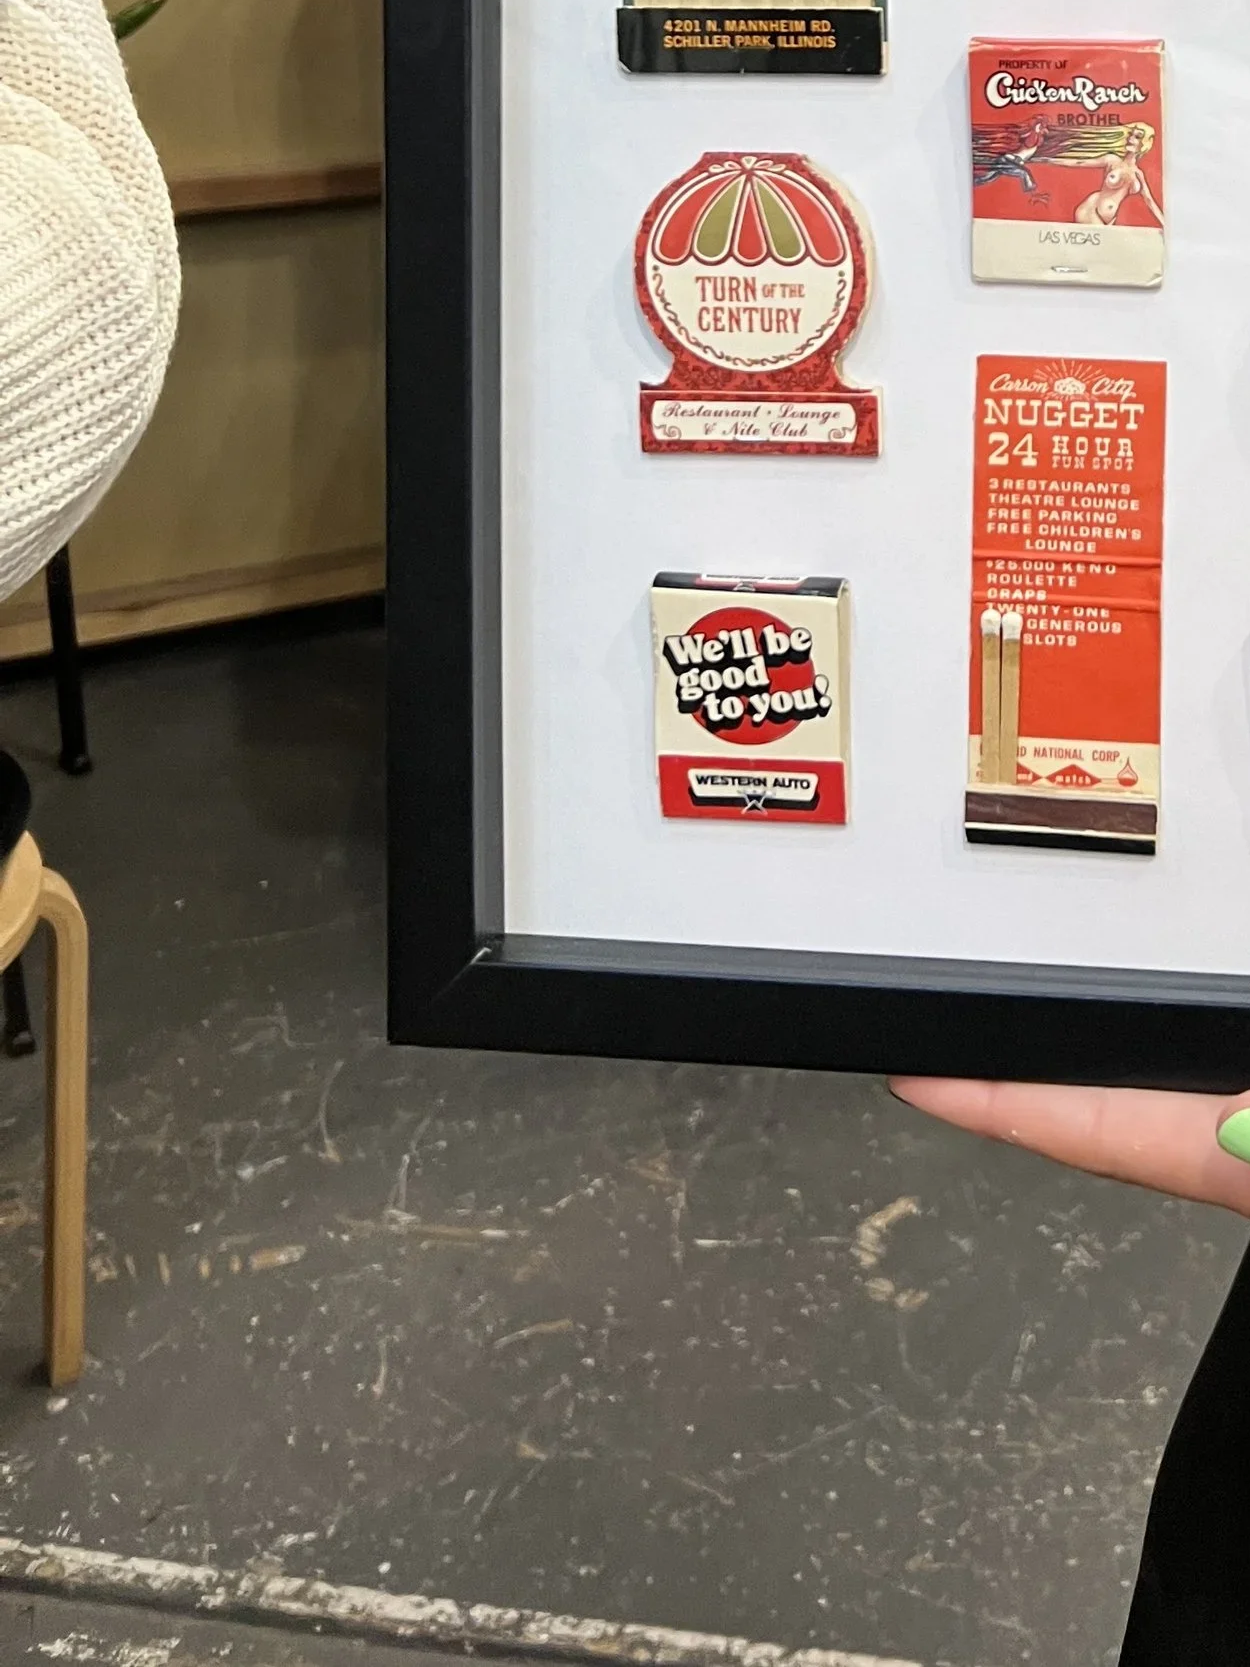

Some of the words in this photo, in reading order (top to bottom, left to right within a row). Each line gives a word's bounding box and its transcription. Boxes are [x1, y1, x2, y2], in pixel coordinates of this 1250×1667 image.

[664, 19, 700, 32] 4201
[706, 19, 721, 32] N.
[725, 19, 805, 32] MANNHEIM
[810, 20, 835, 32] RD.
[664, 35, 731, 48] SCHILLER
[735, 36, 775, 48] PARK,
[778, 36, 836, 48] ILLINOIS
[999, 60, 1053, 70] PROPERTY
[1055, 60, 1069, 70] OF
[1057, 113, 1122, 125] BROTHEL
[1039, 230, 1060, 244] LAS
[1064, 231, 1101, 246] VEGAS
[695, 275, 757, 303] TURN
[762, 283, 779, 298] OF
[780, 283, 806, 299] THE
[698, 306, 803, 334] CENTURY
[989, 373, 1050, 394] Carson
[662, 402, 761, 420] Restaurant
[778, 404, 841, 426] Lounge
[983, 398, 1145, 431] NUGGET
[722, 421, 761, 438] Nite
[769, 422, 808, 438] Club
[988, 431, 1039, 467] 24
[1051, 435, 1134, 458] HOUR
[989, 478, 999, 489] 3
[1003, 479, 1131, 495] RESTAURANTS
[988, 493, 1065, 507] THEATRE
[1071, 496, 1140, 511] LOUNGE
[987, 508, 1032, 521] FREE
[1038, 509, 1118, 524] PARKING
[986, 522, 1032, 535] FREE
[1038, 524, 1142, 541] CHILDREN'S
[1025, 539, 1097, 554] LOUNGE
[1062, 562, 1117, 575] KENO
[986, 572, 1078, 588] ROULETTE
[986, 587, 1047, 601] CRAPS
[1026, 618, 1122, 634] GENEROUS
[664, 627, 760, 672] We'll
[762, 624, 813, 662] be
[1023, 633, 1077, 647] SLOTS
[678, 655, 770, 704] good
[702, 691, 745, 724] to
[749, 674, 833, 724] you!
[1033, 746, 1084, 760] NATIONAL
[696, 774, 767, 787] WESTERN
[772, 777, 811, 790] AUTO
